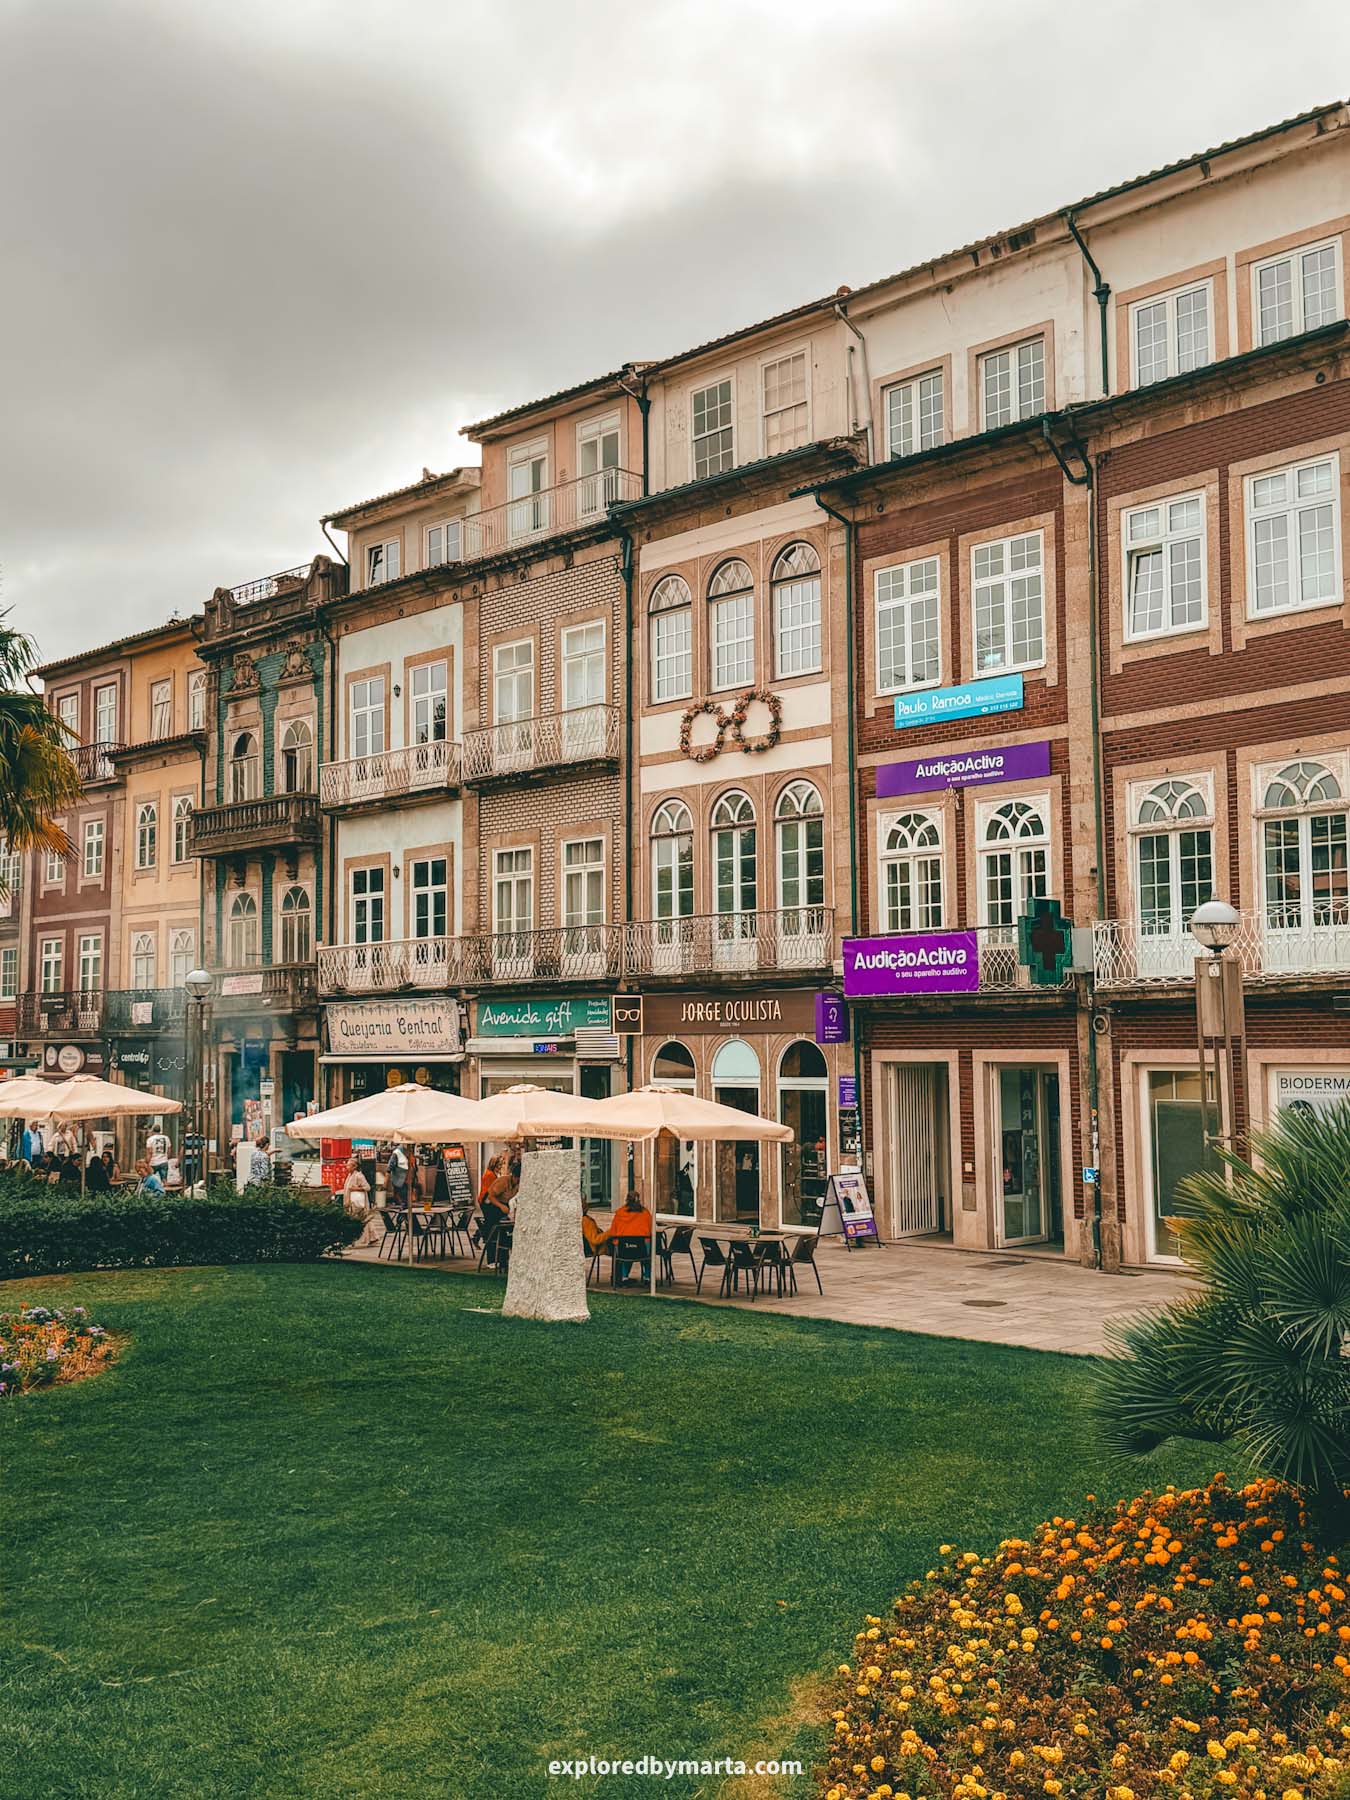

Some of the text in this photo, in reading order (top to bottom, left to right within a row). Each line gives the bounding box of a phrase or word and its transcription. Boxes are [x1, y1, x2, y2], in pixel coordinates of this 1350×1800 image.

[898, 694, 971, 716] Paulo Ramoa
[915, 755, 1004, 778] AudiçãoActiva
[854, 946, 967, 970] AudiçãoActiva
[914, 969, 941, 979] aparelho
[942, 967, 967, 976] auditivo
[481, 1000, 573, 1032] Avenida gift
[681, 999, 782, 1021] JORGE OCULISTA
[340, 1016, 443, 1039] Queijaria Central
